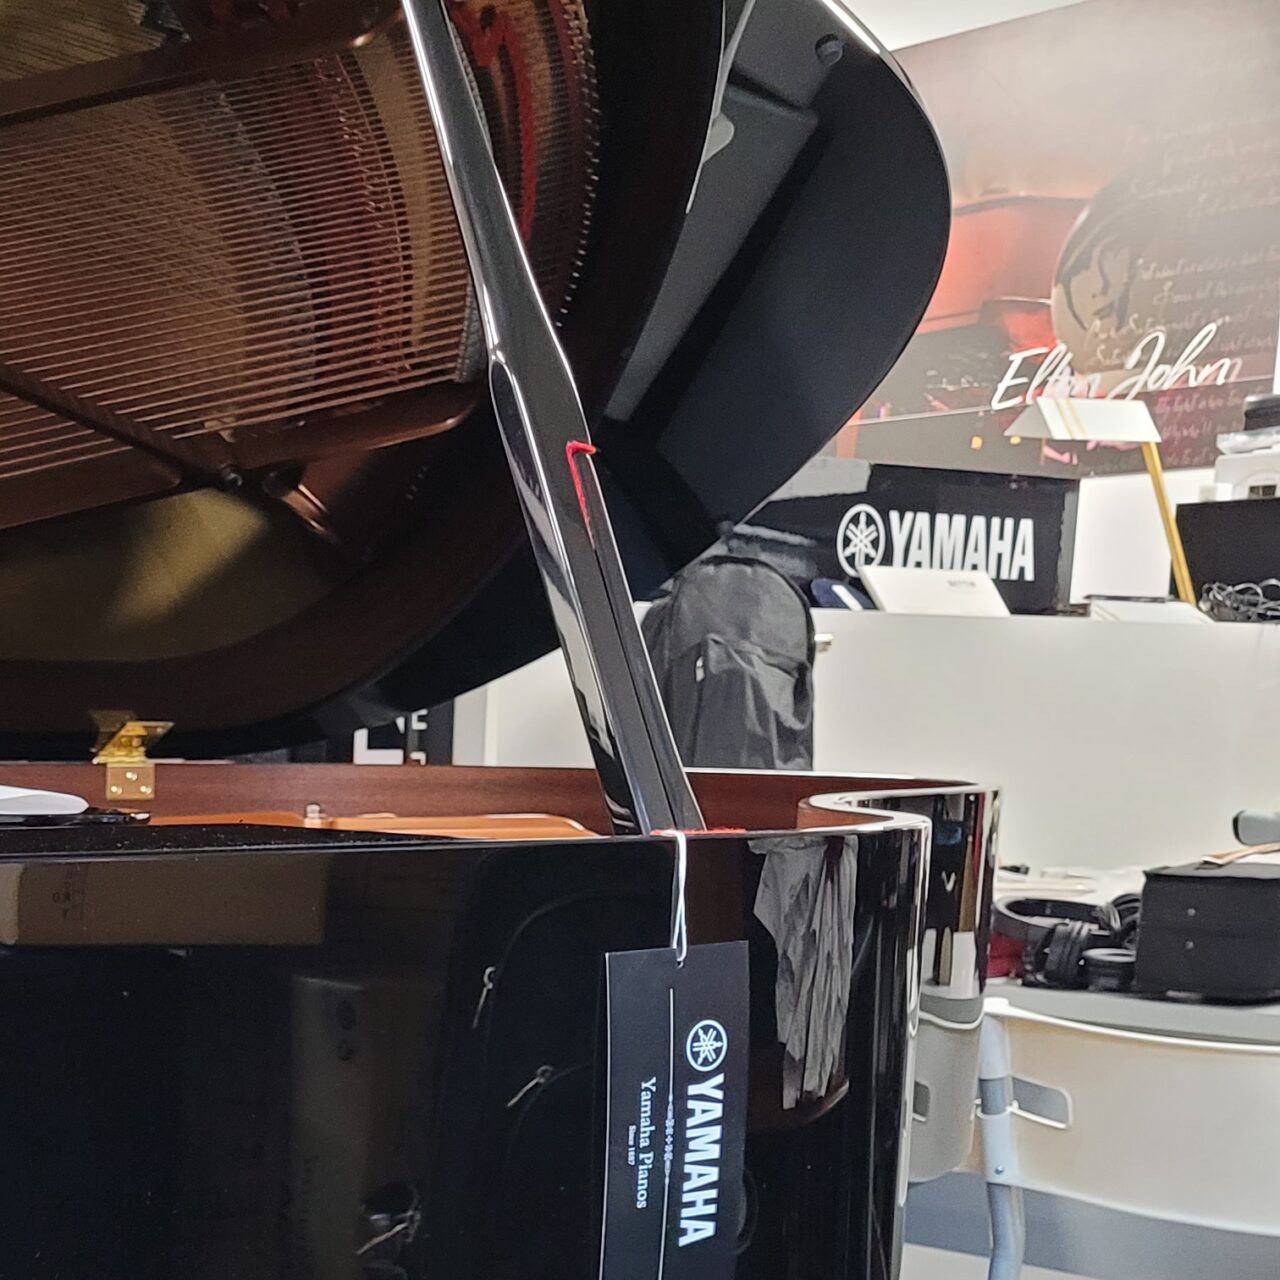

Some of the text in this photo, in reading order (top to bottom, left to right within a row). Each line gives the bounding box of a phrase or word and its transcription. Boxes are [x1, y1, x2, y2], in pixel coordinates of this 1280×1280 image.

[1107, 321, 1243, 401] John
[888, 509, 1035, 582] YAMAHA
[636, 1076, 657, 1209] Yamaha Pianos
[678, 1072, 725, 1248] YAMAHA
